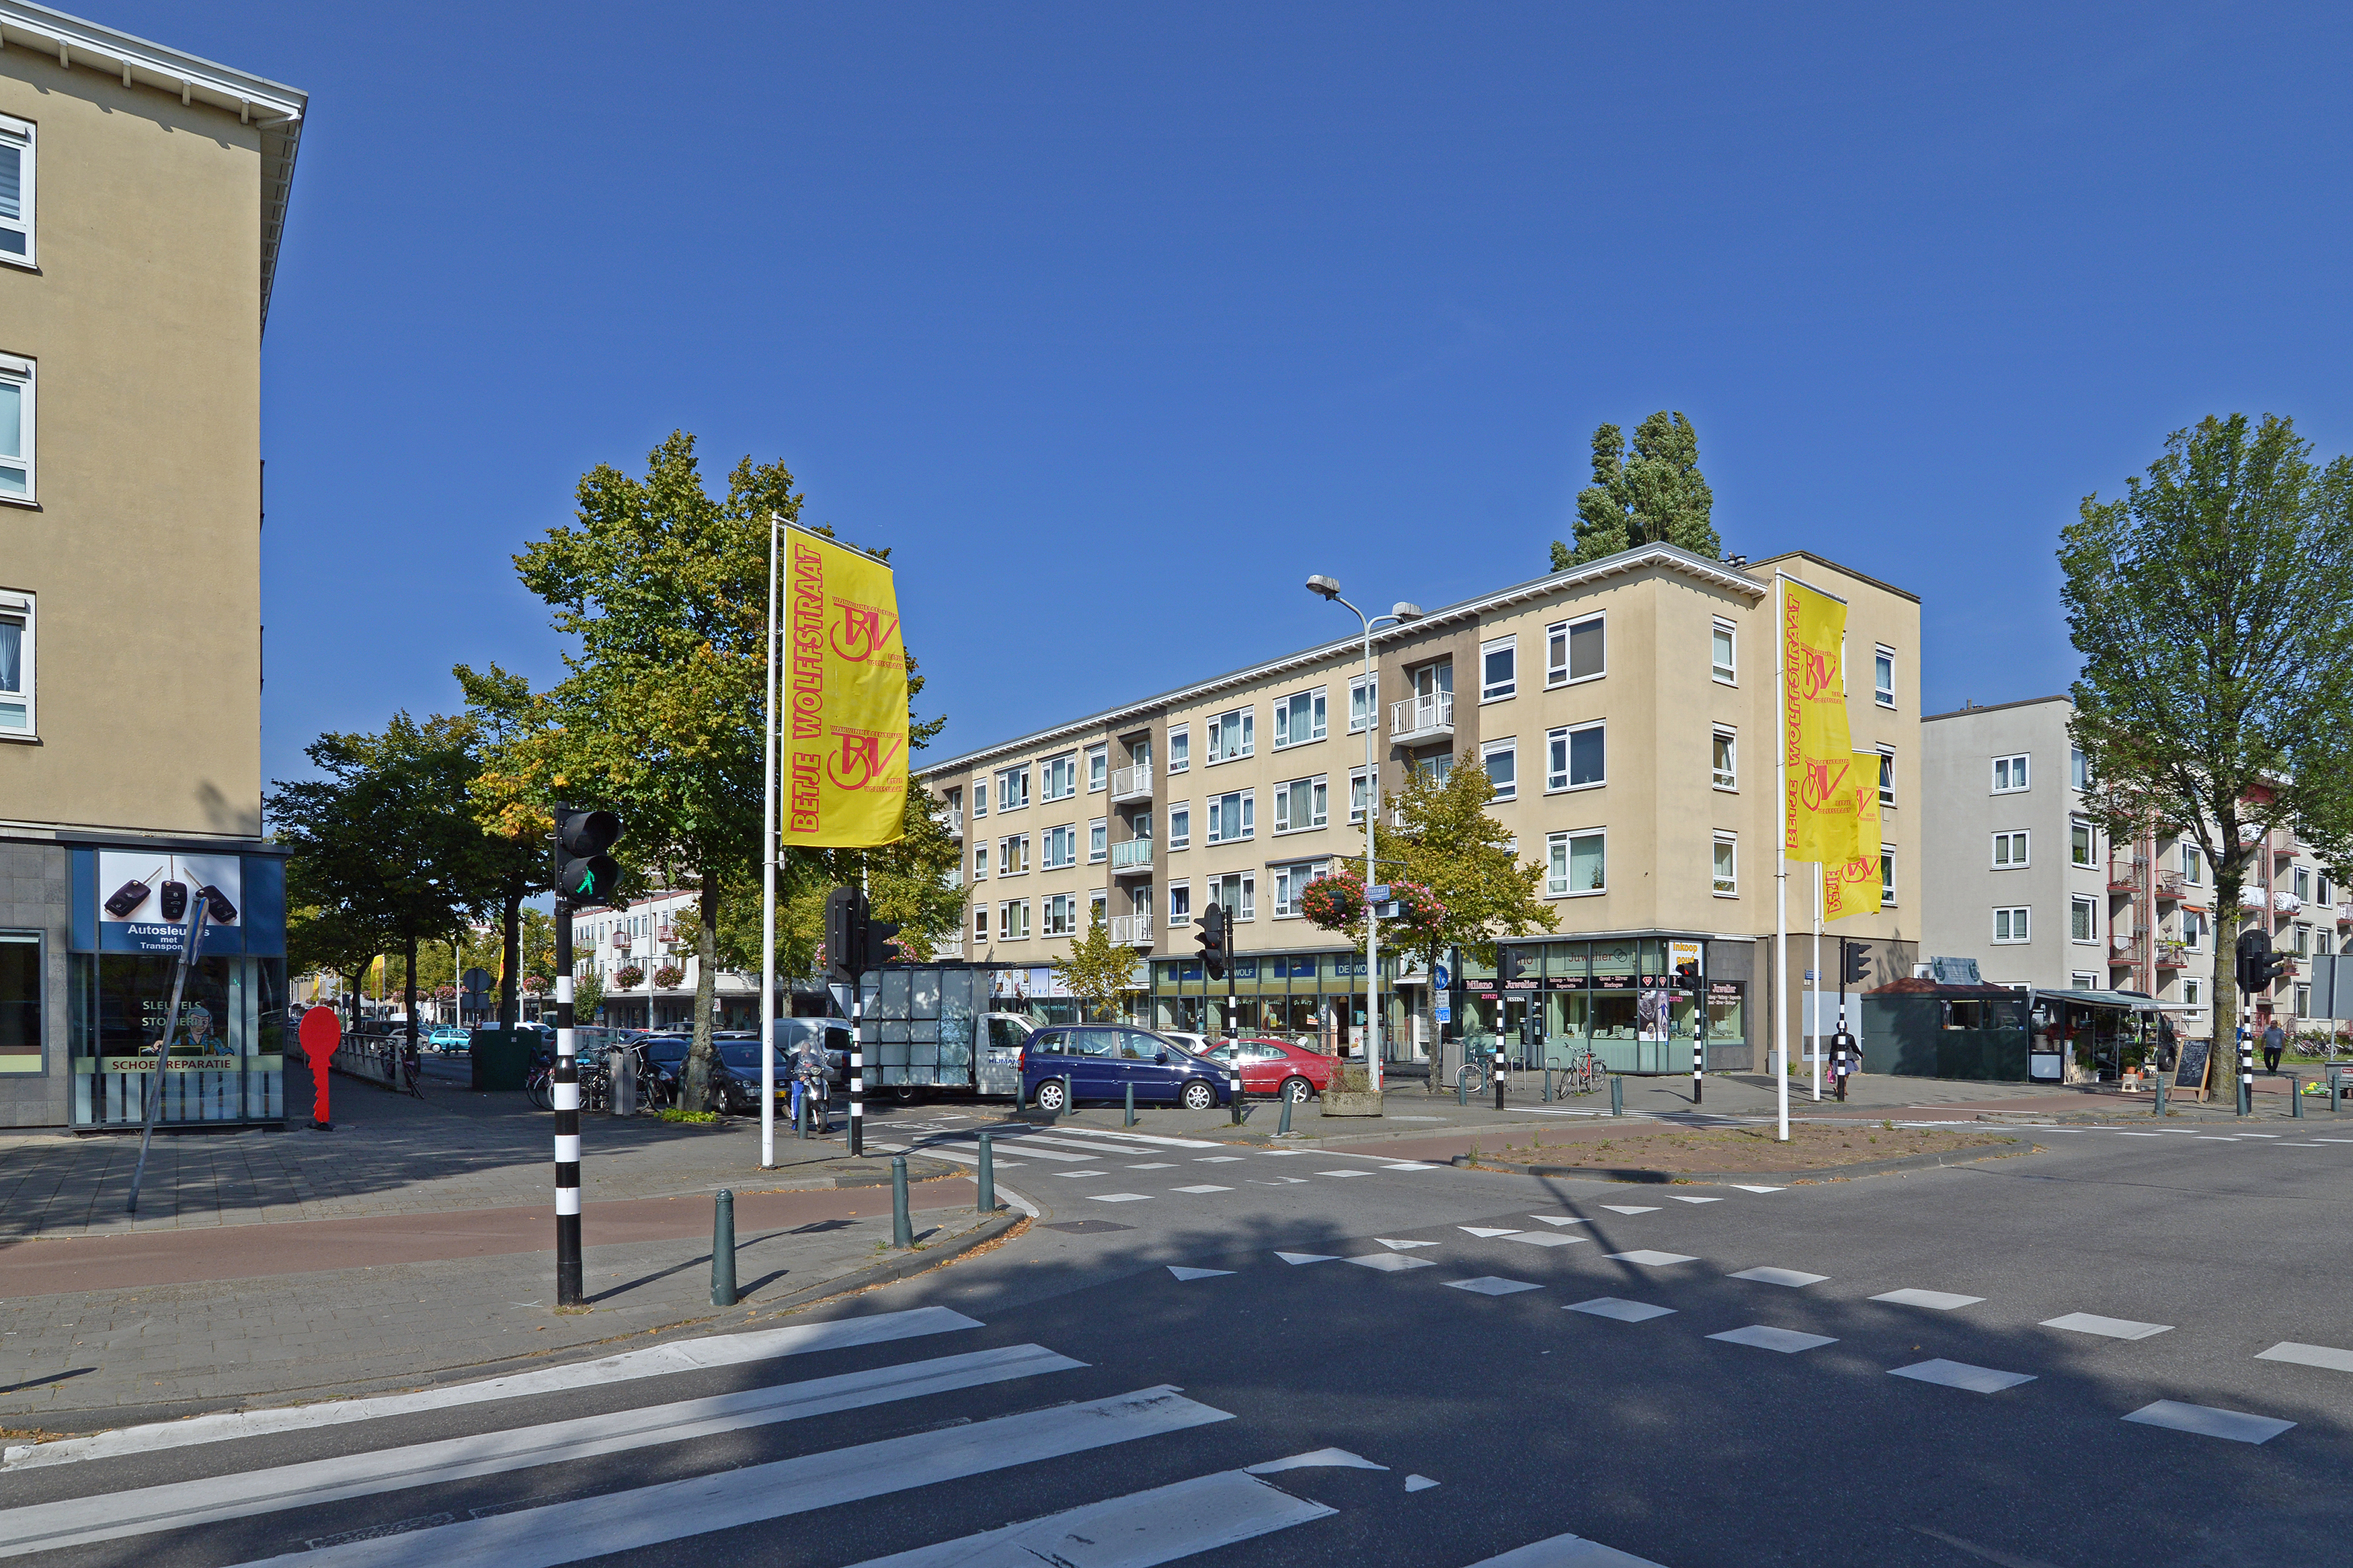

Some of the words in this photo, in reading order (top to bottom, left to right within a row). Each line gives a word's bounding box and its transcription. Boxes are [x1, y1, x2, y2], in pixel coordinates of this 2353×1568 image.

[793, 542, 824, 740] WOLFFSTRAAT
[887, 653, 904, 661] BETJE
[867, 659, 904, 669] WOLFFSTRAAT
[1787, 593, 1801, 767] WOLFFSTRAAT
[830, 725, 904, 738] WIJKWINKELCENTRUM
[791, 752, 821, 833] BETJE
[128, 925, 210, 936] Autosleus
[141, 942, 184, 951] Transpon
[1673, 942, 1698, 954] Inkoop
[1234, 968, 1253, 977] WOLF
[1339, 965, 1349, 973] DE
[1354, 964, 1367, 973] WO
[1466, 981, 1493, 989] Milano
[1505, 980, 1538, 989] Juwelier
[143, 1001, 201, 1009] SLEUELS
[142, 1018, 202, 1026] STOERIJ
[112, 1060, 231, 1070] SCHOEREPARATIE
